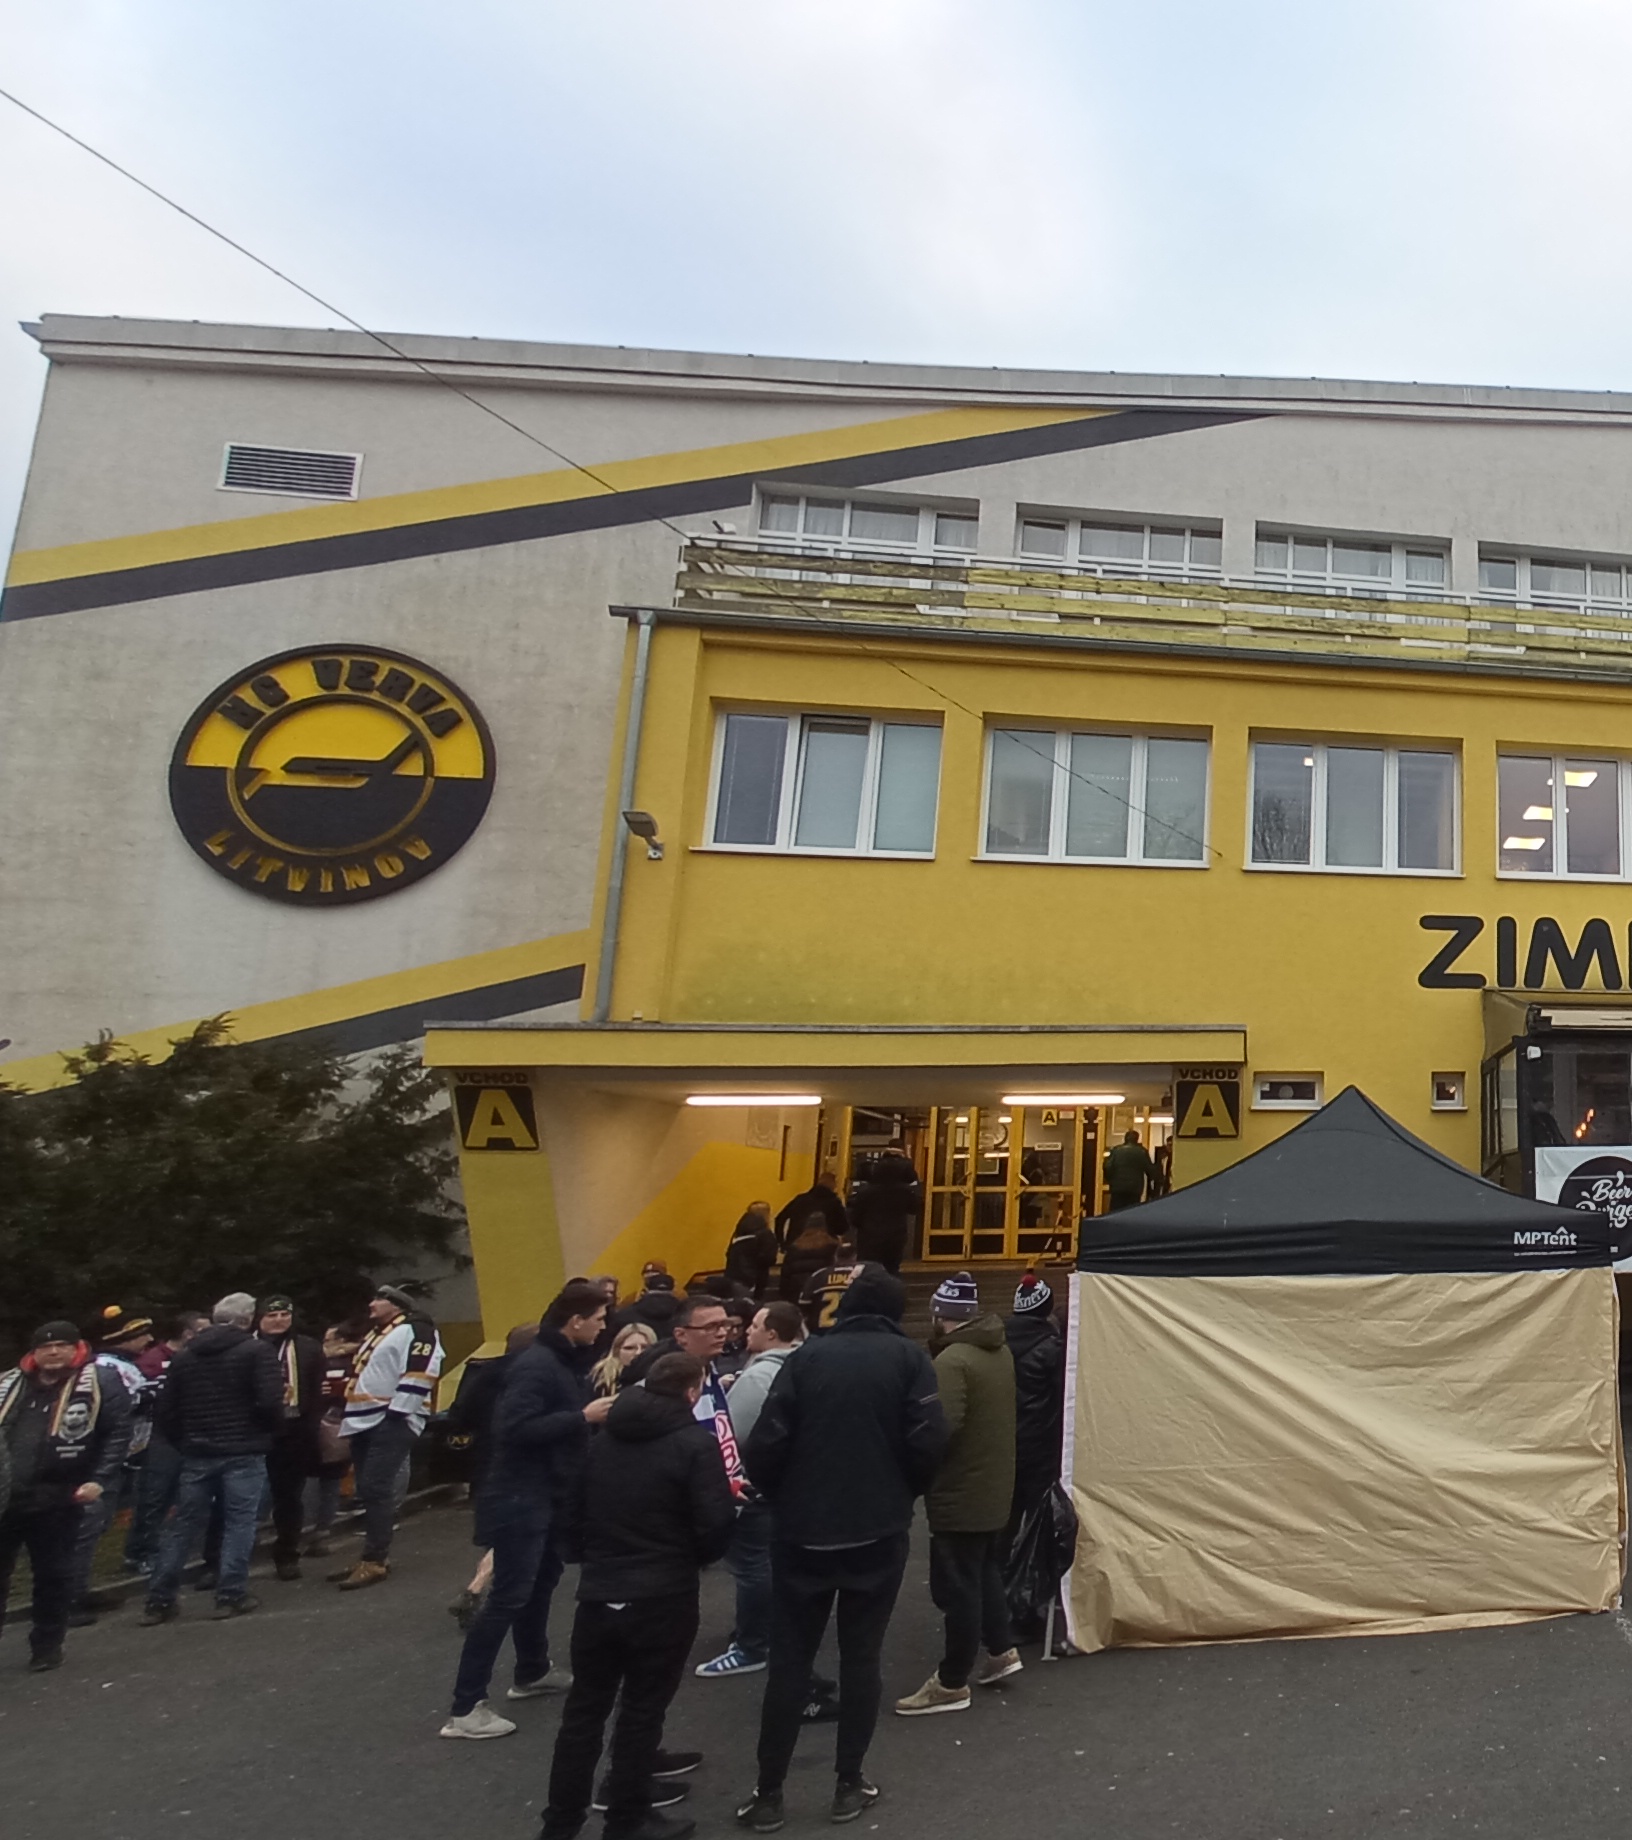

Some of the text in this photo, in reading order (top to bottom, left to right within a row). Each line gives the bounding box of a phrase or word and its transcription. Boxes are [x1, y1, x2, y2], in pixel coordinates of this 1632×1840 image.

[216, 657, 464, 739] HC VERVA
[204, 831, 432, 893] LITVINOV
[457, 1071, 529, 1085] VCHOD
[1178, 1068, 1239, 1080] VCHOD
[465, 1089, 538, 1148] A
[1043, 1111, 1056, 1123] A
[1178, 1084, 1238, 1136] A
[1592, 1179, 1632, 1201] Beer
[1513, 1230, 1578, 1246] MPTent
[411, 1342, 432, 1356] 28
